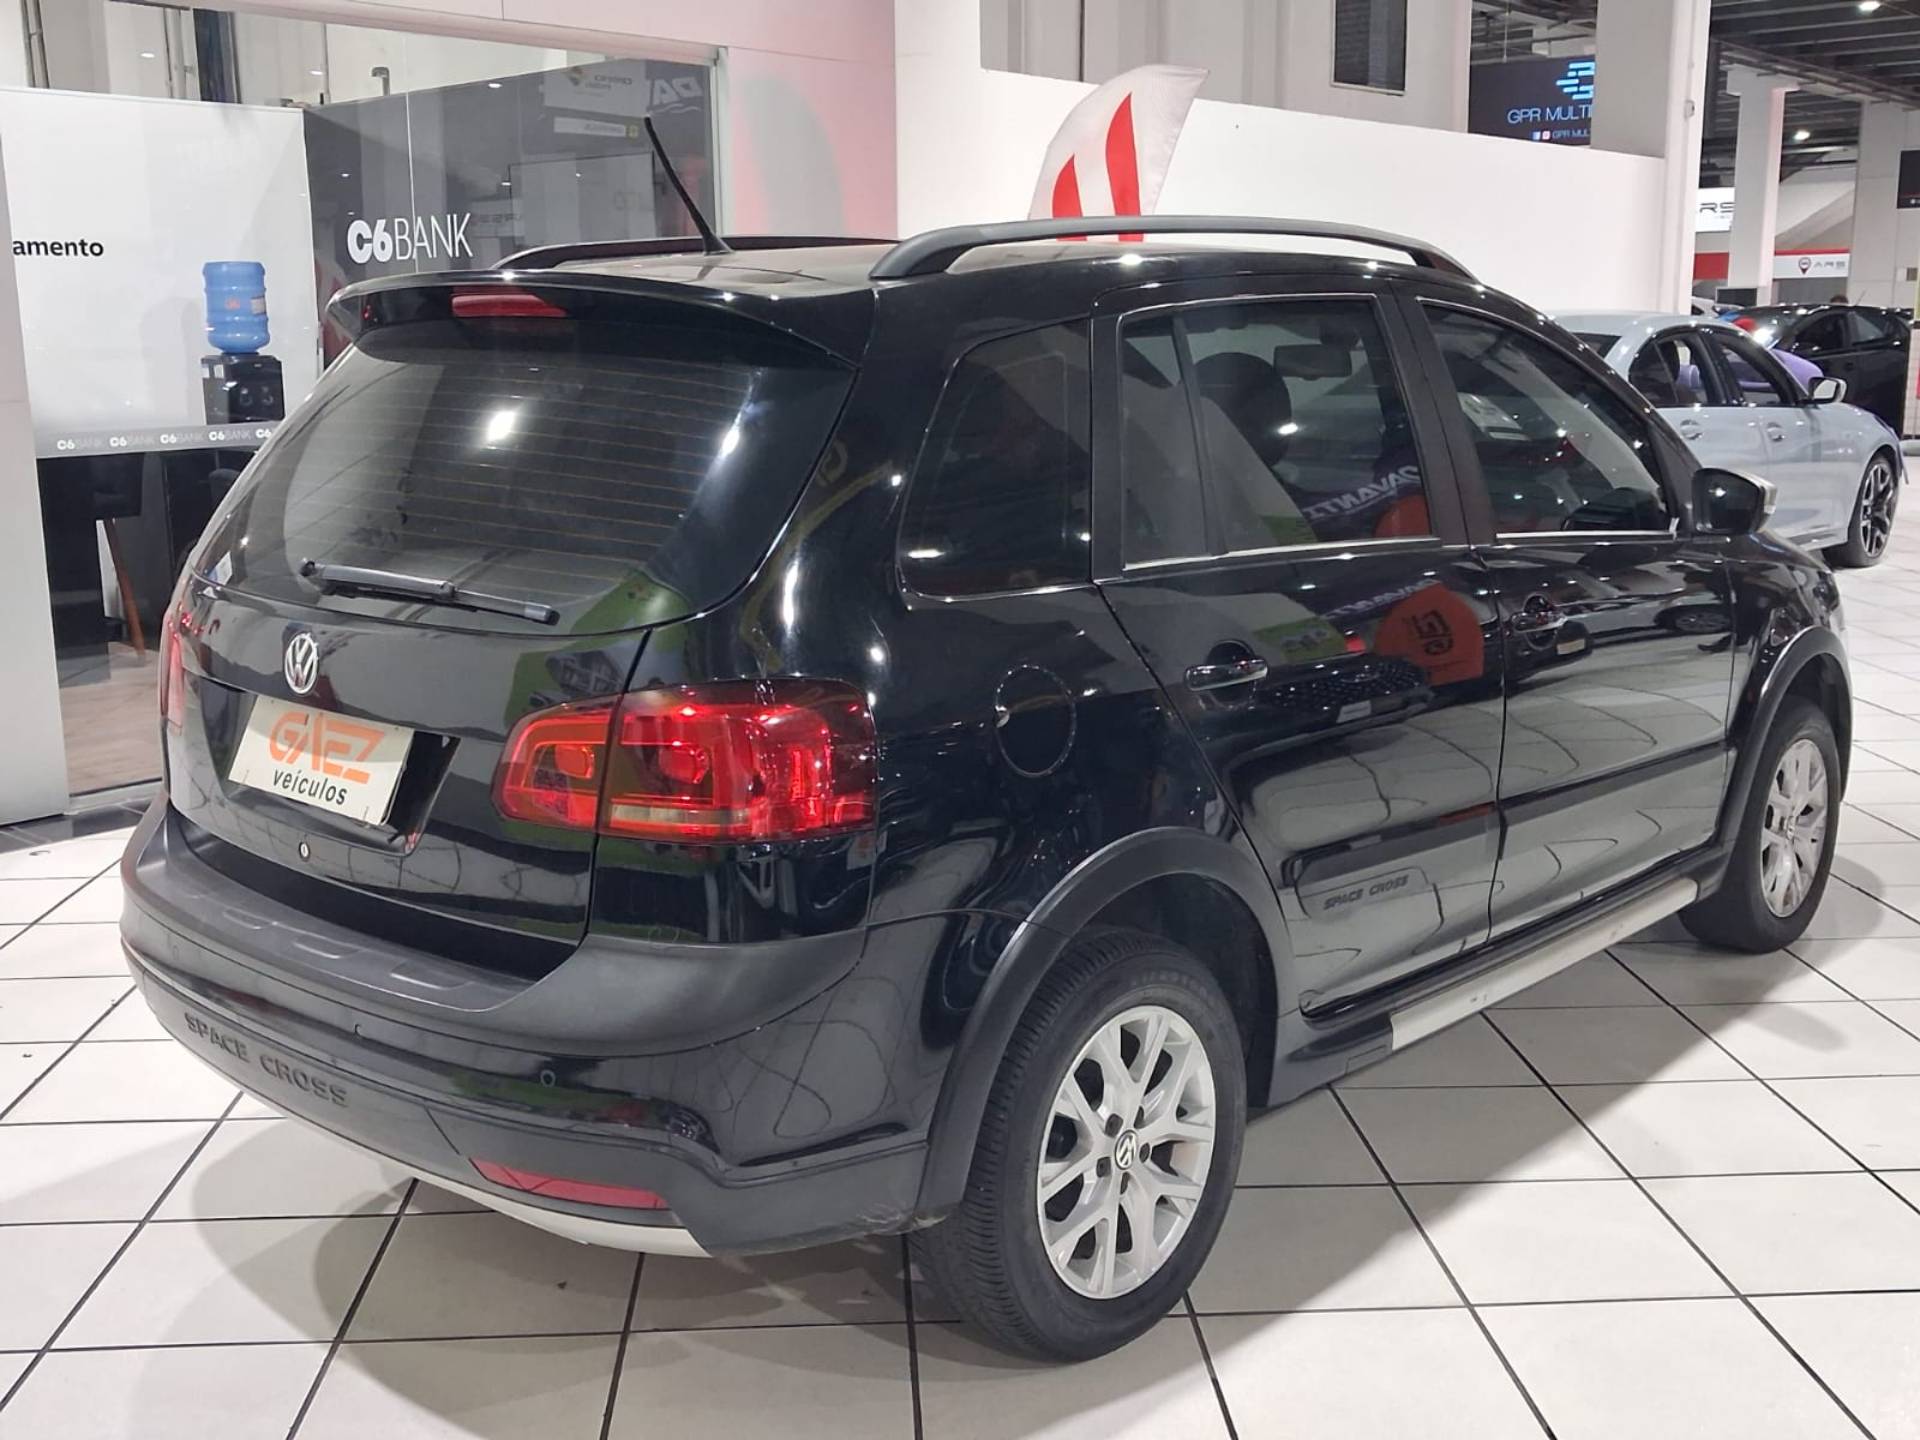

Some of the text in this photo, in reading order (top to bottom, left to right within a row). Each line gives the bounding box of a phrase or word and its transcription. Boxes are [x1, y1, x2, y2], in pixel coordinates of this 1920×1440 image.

[1507, 107, 1541, 124] GPR
[12, 239, 104, 257] amento
[273, 768, 348, 806] veículos
[1323, 874, 1409, 910] SPACE CROSS
[184, 1011, 348, 1109] SPACE CROSS
